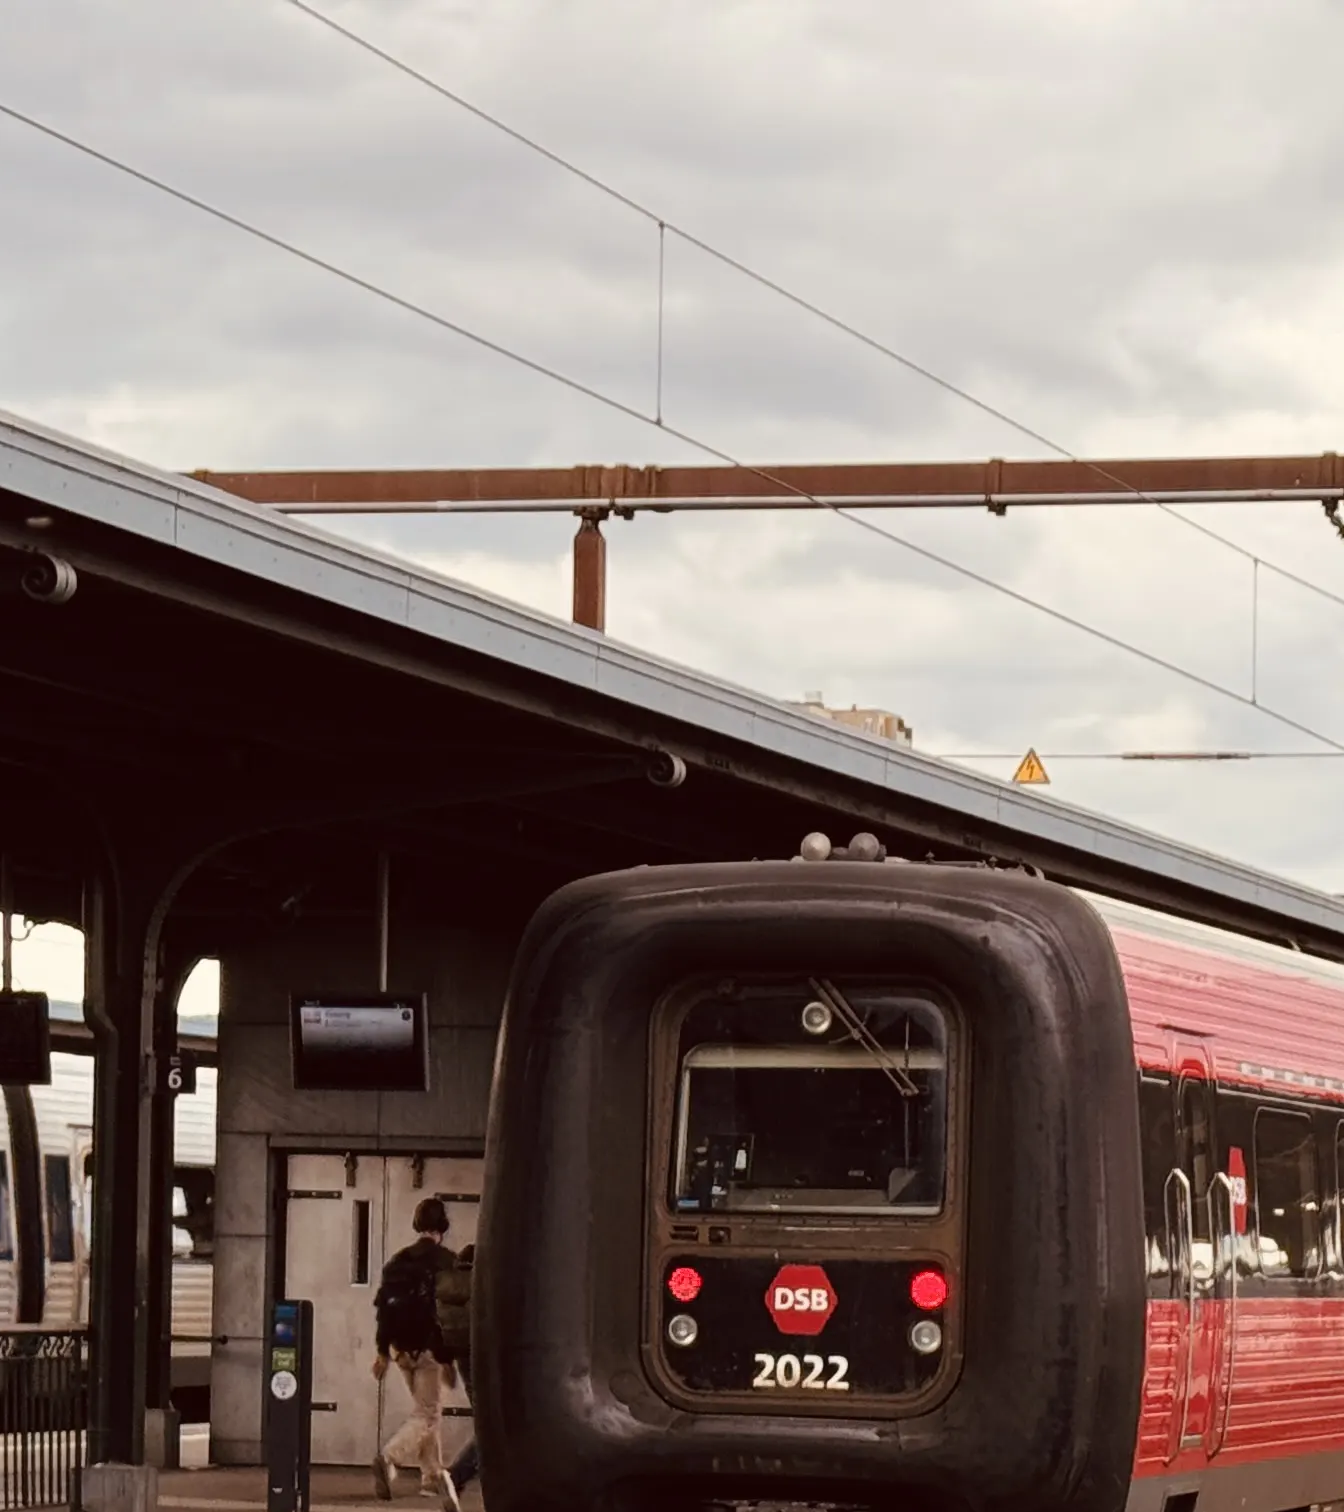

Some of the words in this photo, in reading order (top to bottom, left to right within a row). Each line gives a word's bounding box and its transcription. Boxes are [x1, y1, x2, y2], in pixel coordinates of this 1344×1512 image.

[168, 1068, 182, 1089] 6
[774, 1287, 828, 1311] DSB
[753, 1353, 850, 1390] 2022
